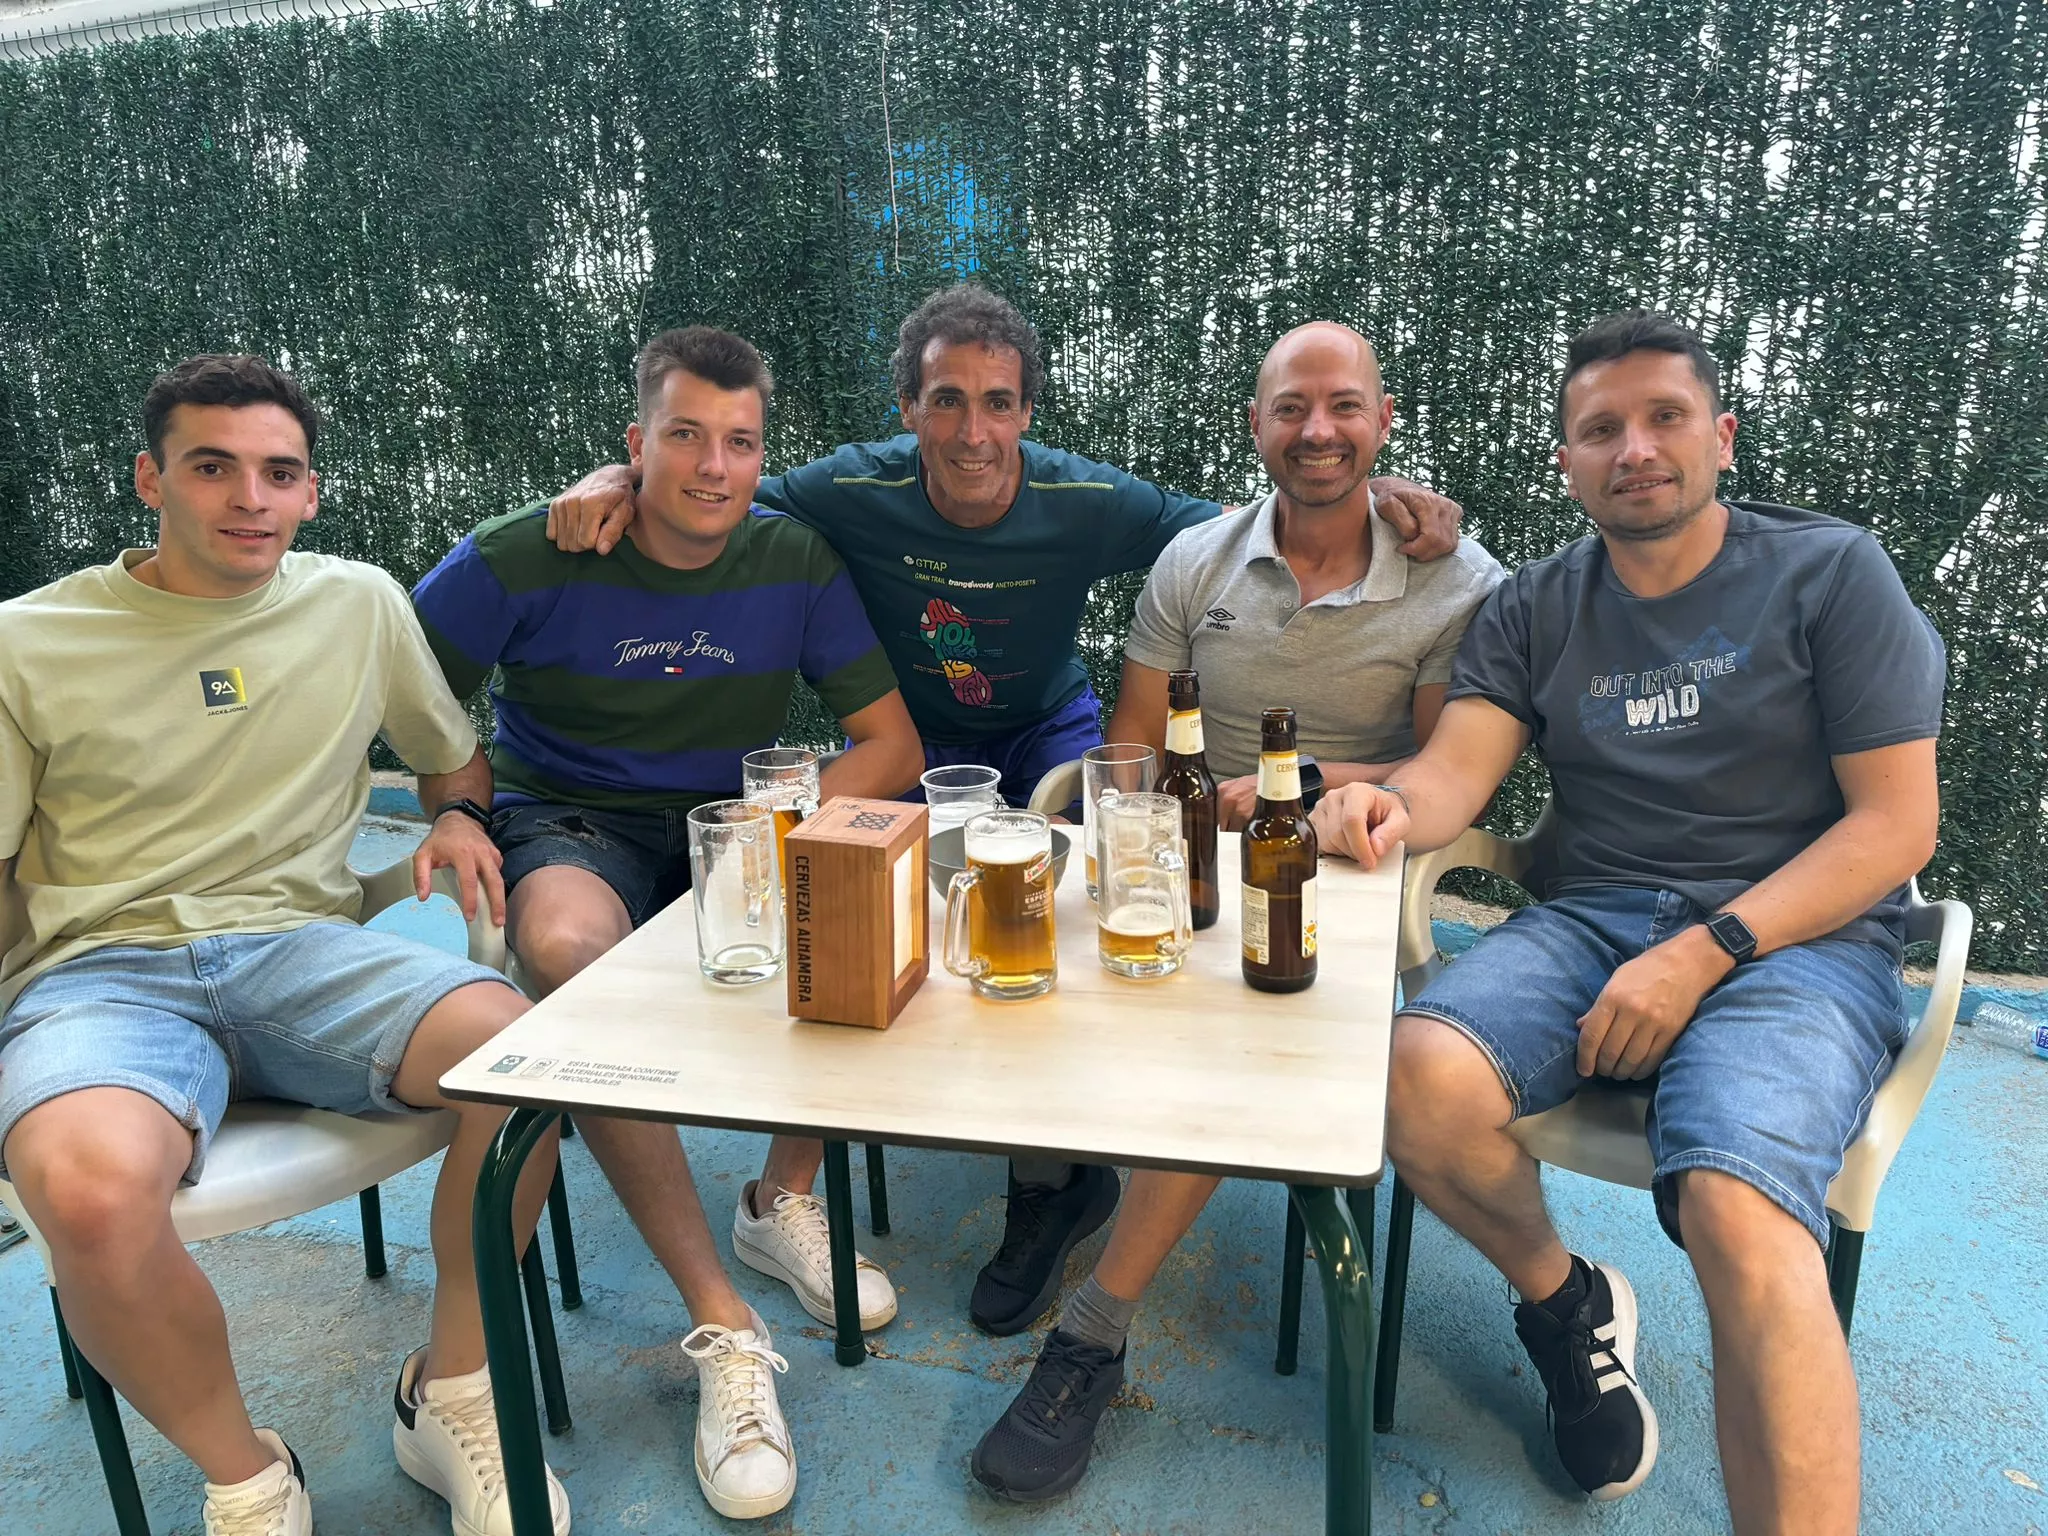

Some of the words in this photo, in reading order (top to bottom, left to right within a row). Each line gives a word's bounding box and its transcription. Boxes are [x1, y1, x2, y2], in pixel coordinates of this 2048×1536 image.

[915, 558, 948, 572] GTTAP
[914, 572, 930, 581] GRAN
[931, 575, 946, 585] TRAIL
[920, 597, 970, 632] ALL
[1206, 622, 1230, 631] umbro
[613, 637, 684, 667] Tommy
[683, 630, 735, 664] Jeans
[1590, 673, 1636, 697] OUT
[1641, 662, 1684, 695] INTO
[1689, 652, 1737, 681] THE
[207, 705, 249, 717] JACK&JONES
[1625, 684, 1701, 727] WILD
[795, 855, 812, 923] CERVEZAS
[797, 928, 812, 1004] ALHAMBRA
[559, 1067, 616, 1078] MATERIALES
[615, 1073, 678, 1084] RENOVABLES
[567, 1060, 590, 1068] ESTA
[592, 1062, 632, 1073] TERRAZA
[633, 1066, 681, 1077] CONTIENE
[559, 1075, 622, 1086] RECICLABLES
